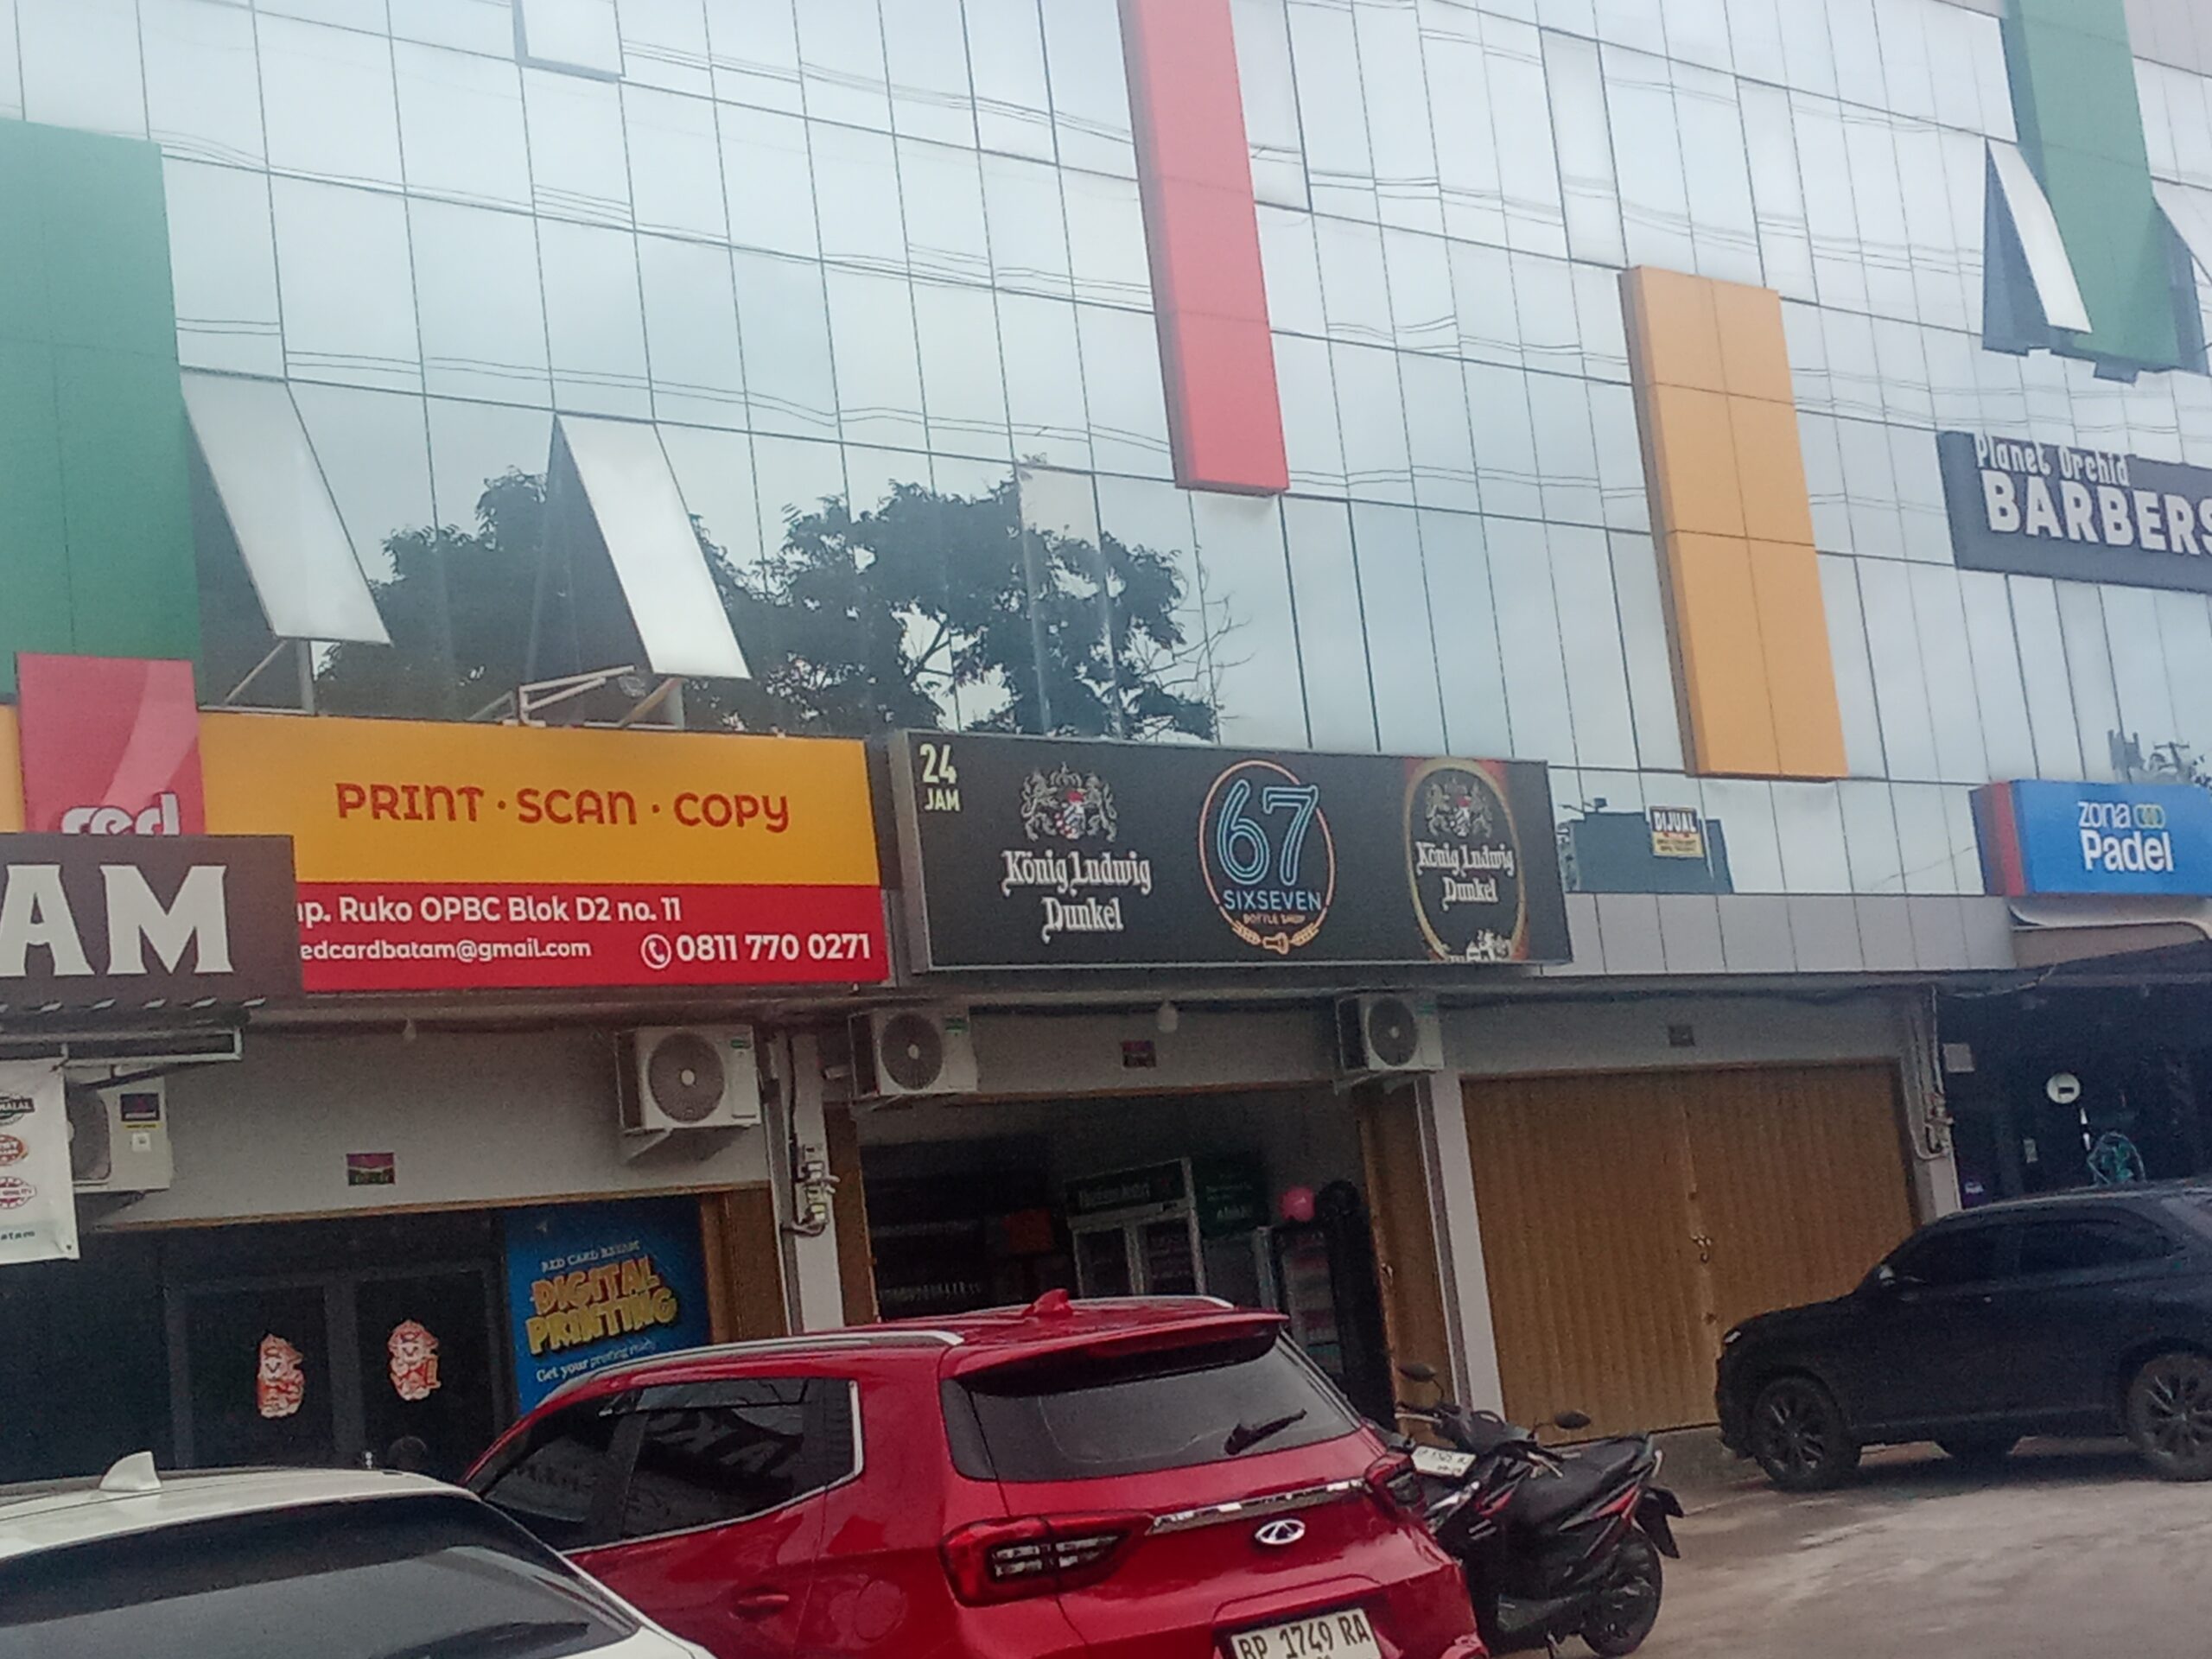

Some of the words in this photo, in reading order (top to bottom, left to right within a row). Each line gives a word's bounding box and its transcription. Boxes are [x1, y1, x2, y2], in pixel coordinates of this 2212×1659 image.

[1974, 433, 2051, 475] Planet
[2057, 445, 2130, 486] Orchid
[919, 743, 957, 785] 24
[335, 782, 485, 823] PRINT
[516, 788, 638, 825] SCAN
[925, 788, 961, 811] JAM
[2077, 801, 2132, 829] zona
[1217, 779, 1319, 886] 67
[2080, 830, 2175, 872] Padel
[1001, 849, 1069, 898] König
[1068, 849, 1152, 897] Ludwig
[1459, 842, 1515, 878] Ludwig
[296, 901, 332, 929] p.
[339, 895, 413, 922] Ruko
[420, 896, 501, 922] OPBC
[507, 895, 570, 922] Blok
[575, 896, 612, 921] D2
[617, 901, 658, 922] no.
[660, 896, 682, 921] 11
[1223, 889, 1321, 912] SIXSEVEN
[1441, 876, 1499, 912] Dunkel
[1040, 896, 1124, 944] Dunkel
[676, 934, 738, 961] 0811
[745, 934, 800, 961] 770
[807, 933, 870, 960] 0271
[531, 1255, 660, 1315] DIGITAL
[525, 1287, 678, 1355] PRINTING
[536, 1368, 559, 1382] Get
[560, 1358, 589, 1379] your
[1279, 1620, 1334, 1659] 1749
[1338, 1613, 1371, 1646] RA
